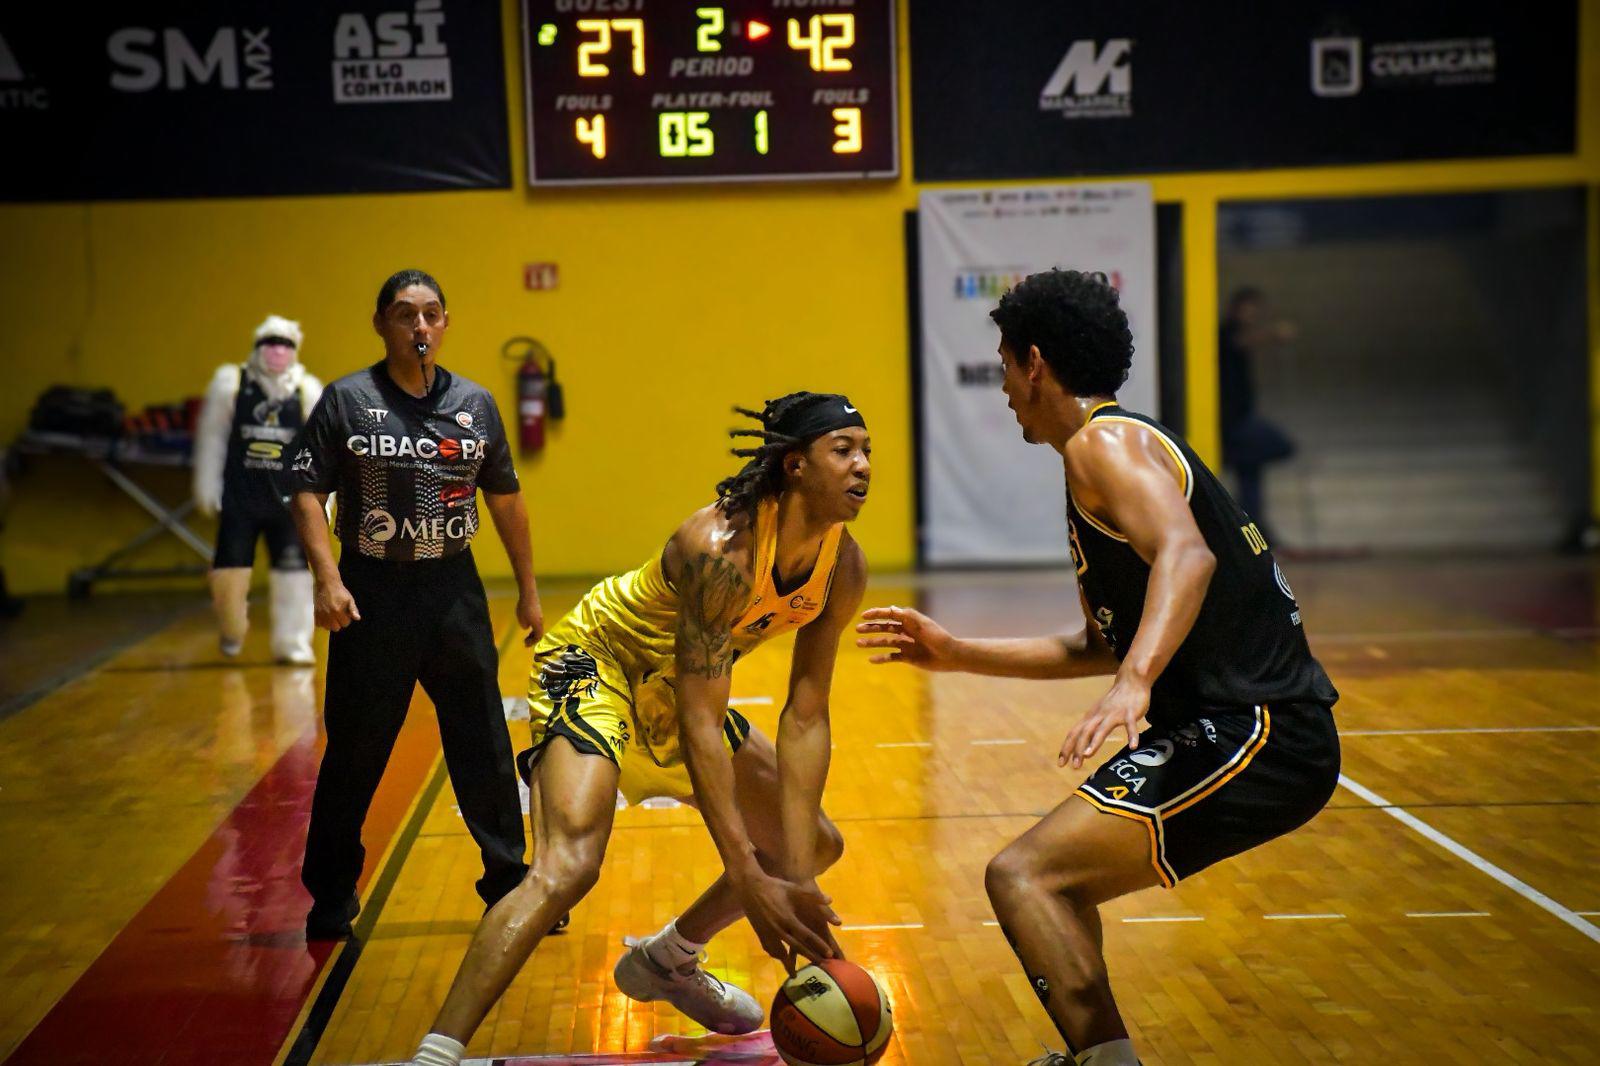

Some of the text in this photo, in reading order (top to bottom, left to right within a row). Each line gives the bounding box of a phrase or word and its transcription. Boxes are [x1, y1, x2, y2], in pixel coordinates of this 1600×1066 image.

[576, 18, 646, 77] 27
[695, 7, 724, 52] 2
[786, 13, 856, 72] 42
[342, 63, 402, 80] ME LO
[670, 57, 754, 78] PERIOD
[556, 94, 612, 111] FOULS
[651, 91, 774, 108] PLAYER-FOUL
[812, 88, 869, 105] FOULS
[575, 113, 606, 160] 4
[659, 111, 715, 157] 05
[754, 109, 769, 155] 1
[832, 107, 863, 153] 3
[400, 513, 476, 540] MEGA
